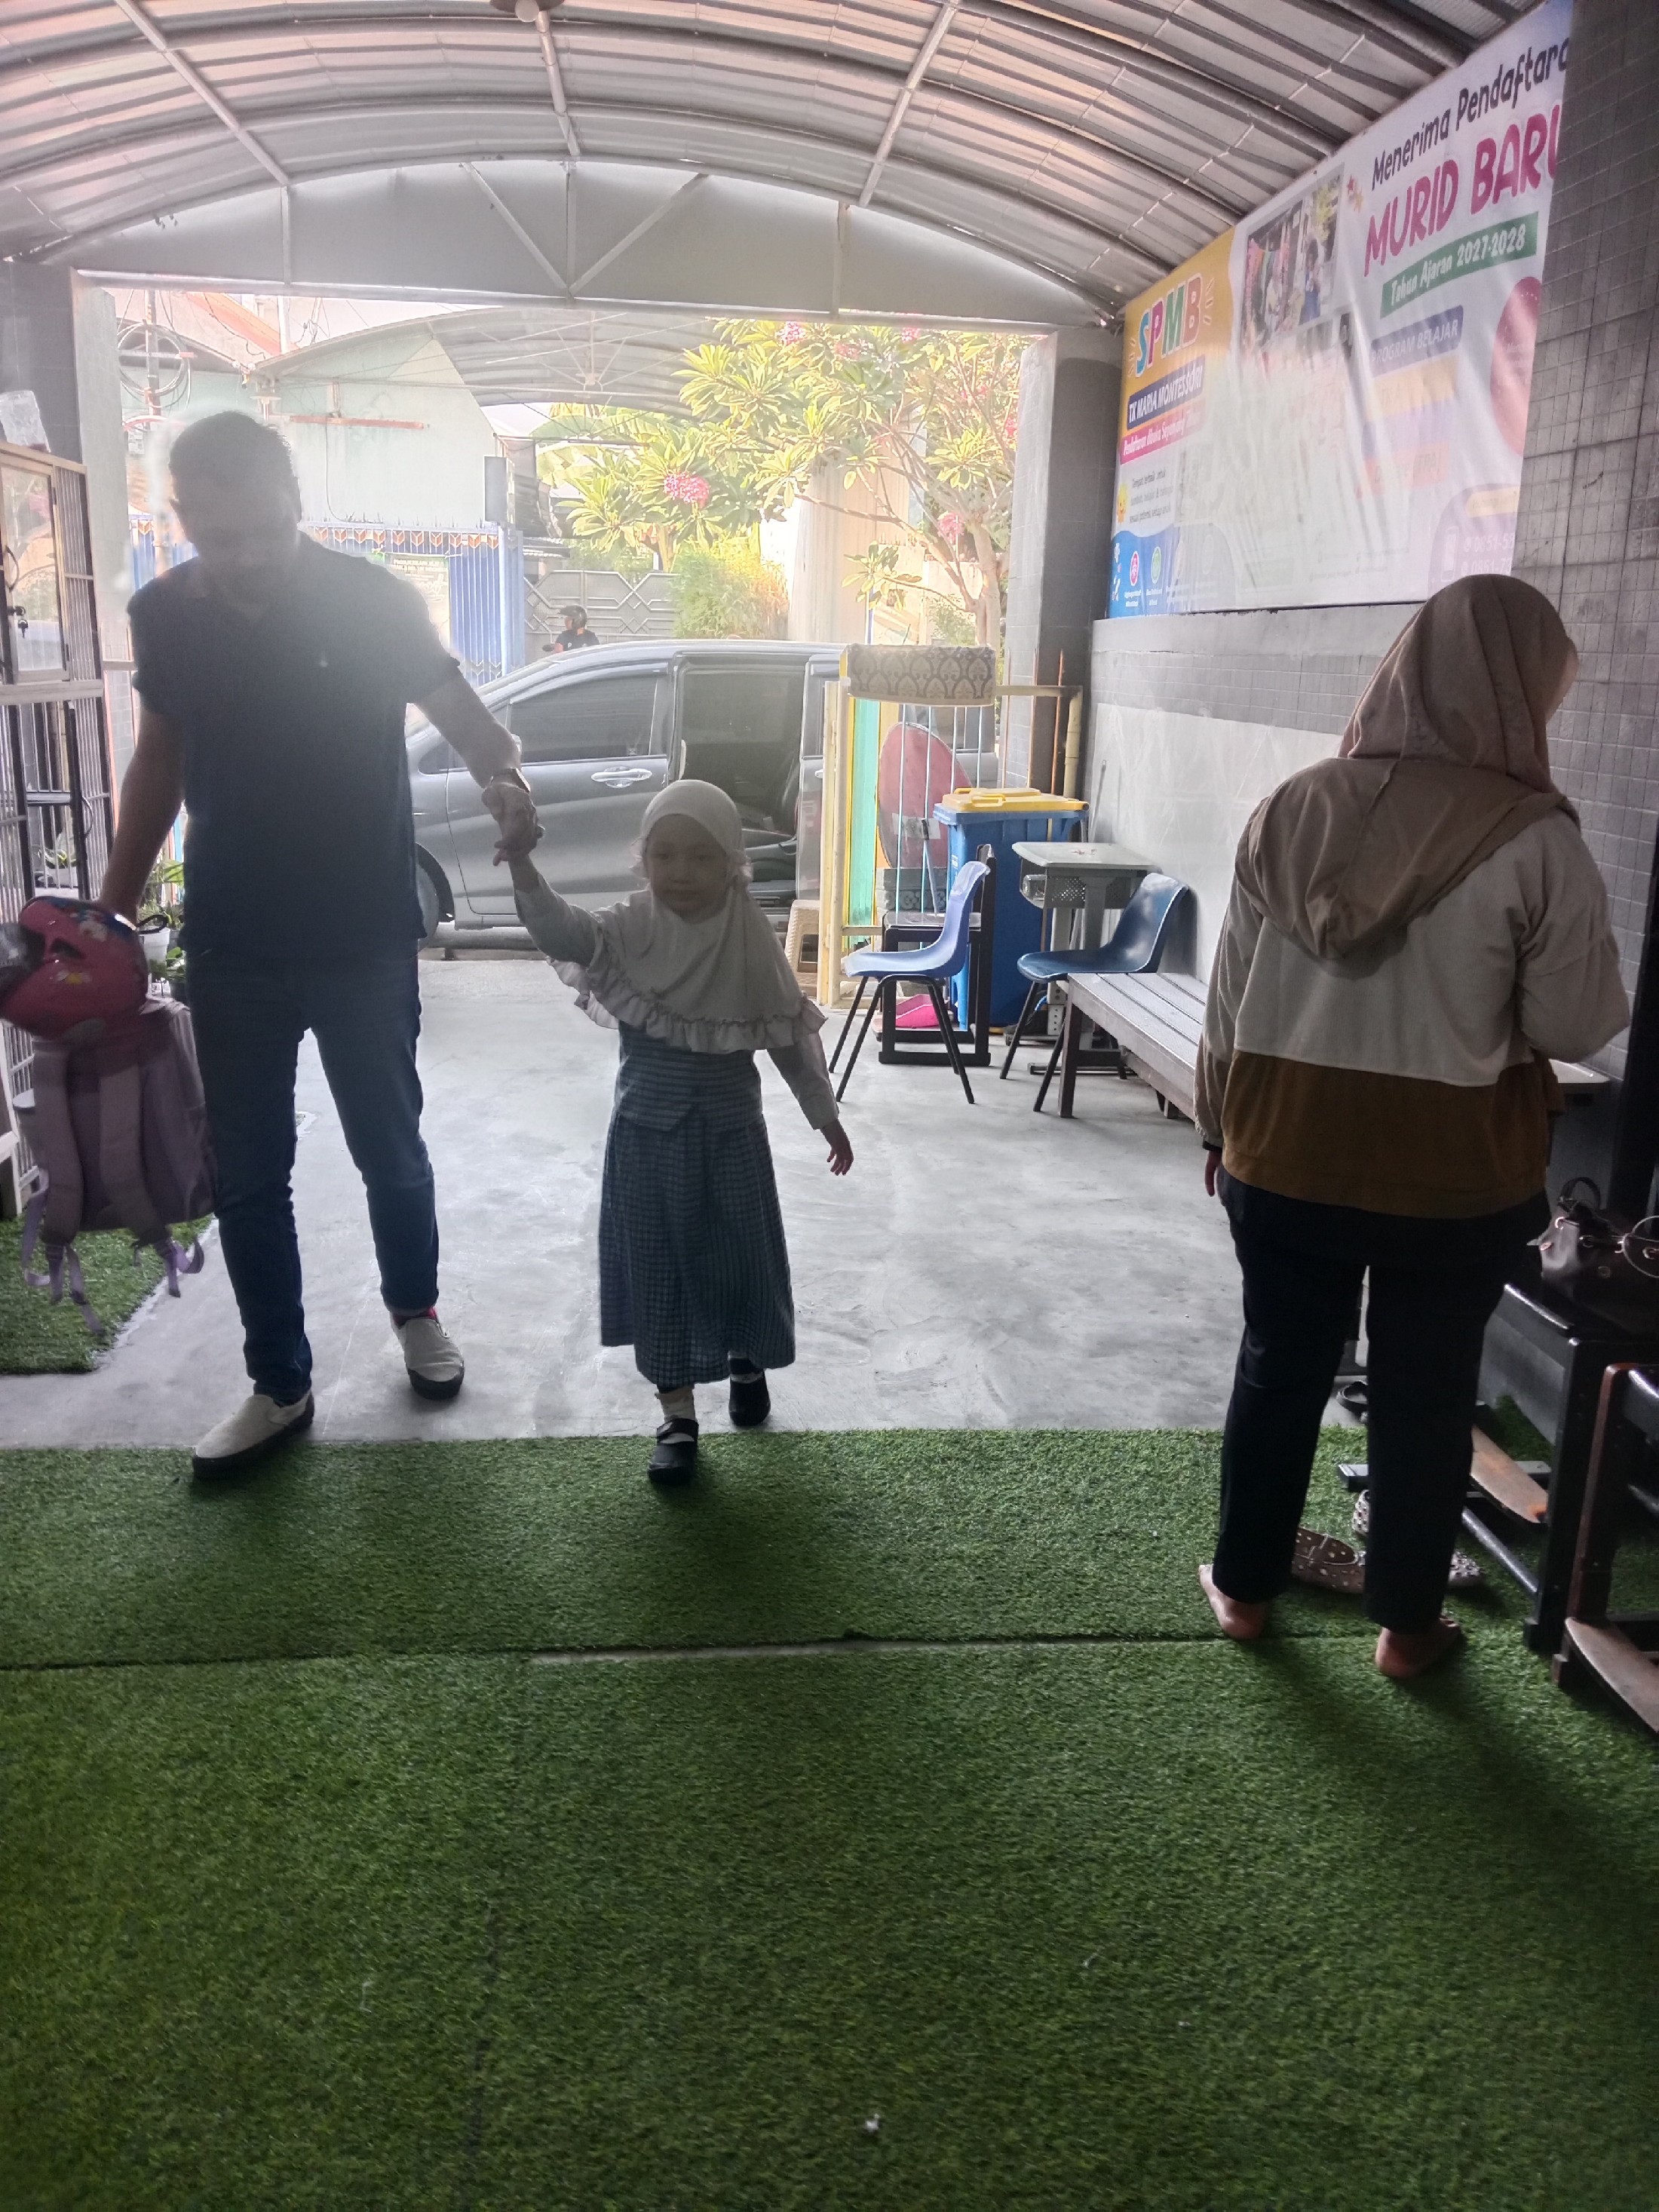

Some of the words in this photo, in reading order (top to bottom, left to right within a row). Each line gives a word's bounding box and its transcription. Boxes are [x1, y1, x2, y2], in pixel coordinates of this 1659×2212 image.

[1372, 109, 1451, 191] Menerima
[1364, 159, 1458, 277] MURID
[1391, 275, 1418, 305] Tahun
[1420, 255, 1452, 288] Ajaran
[1136, 273, 1202, 378] SPMB
[1372, 336, 1415, 363] PROGRAM
[1418, 319, 1458, 349] BELAJAR
[1129, 401, 1138, 423] TK
[1136, 390, 1158, 419] MARIA
[1158, 362, 1204, 408] MONTESSORI
